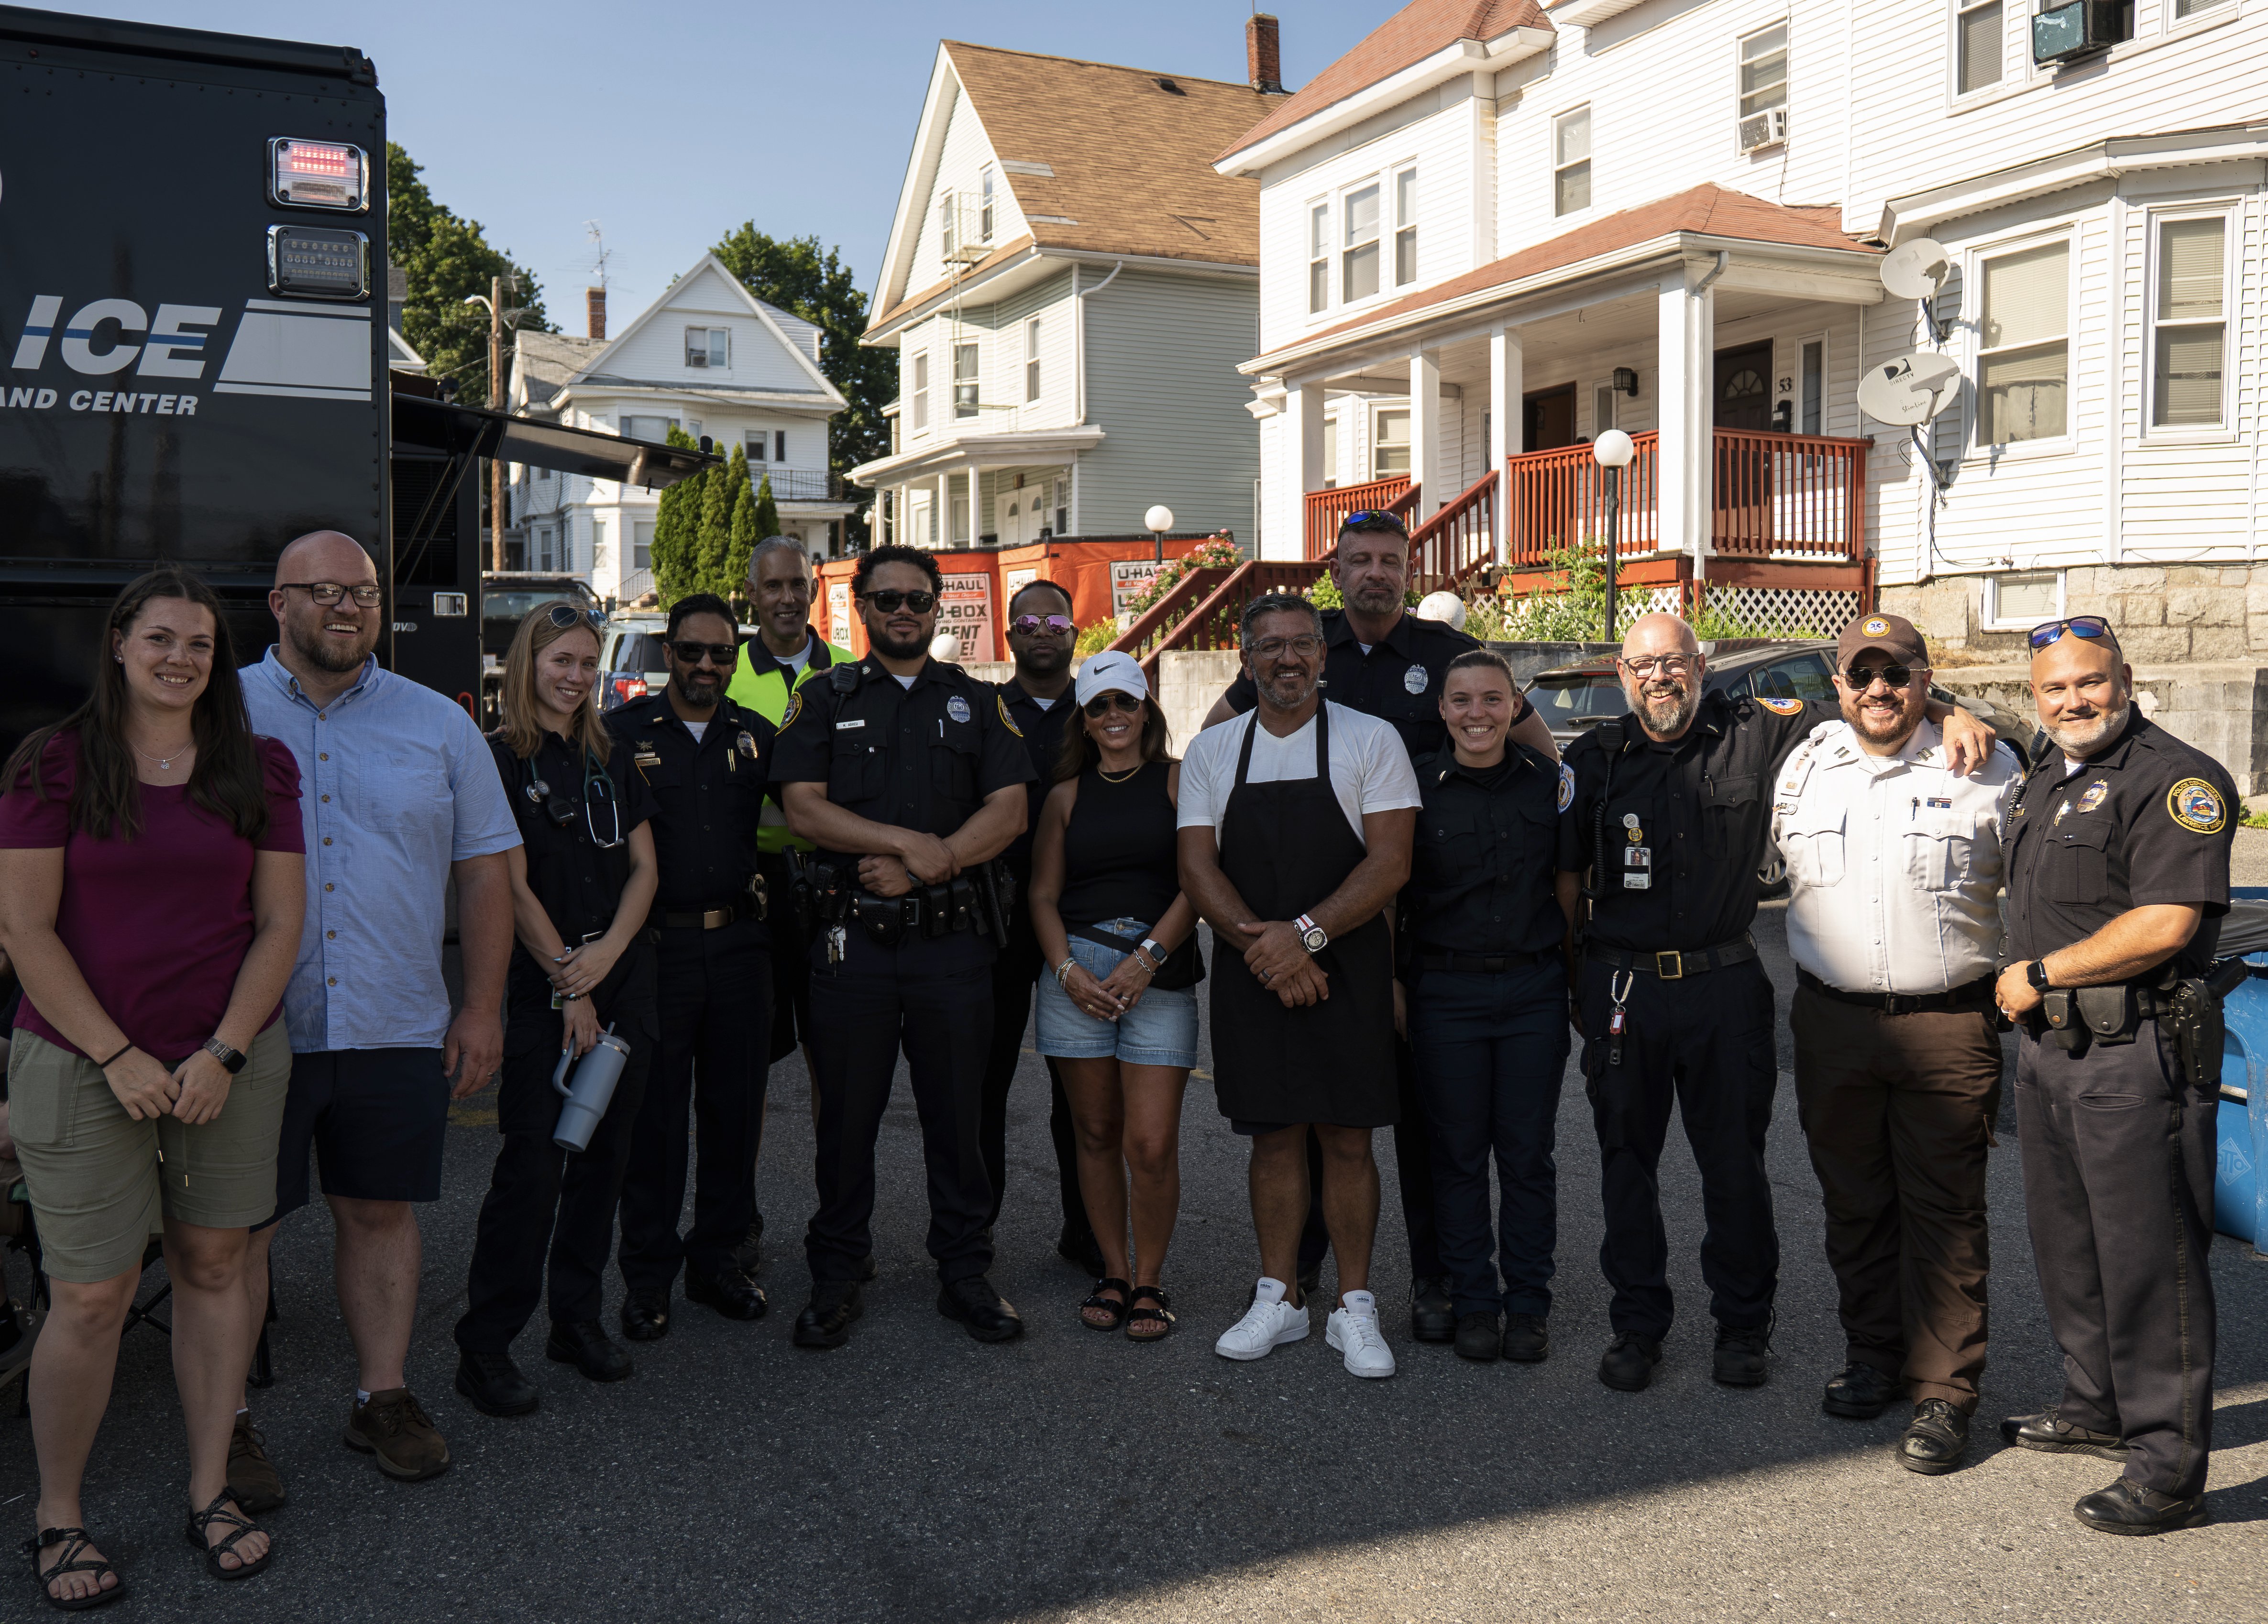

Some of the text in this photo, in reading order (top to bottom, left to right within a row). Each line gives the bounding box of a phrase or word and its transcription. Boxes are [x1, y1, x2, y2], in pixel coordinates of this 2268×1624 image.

[1778, 376, 1792, 393] 53
[0, 387, 198, 415] ND CENTER
[2173, 782, 2189, 797] POLICE
